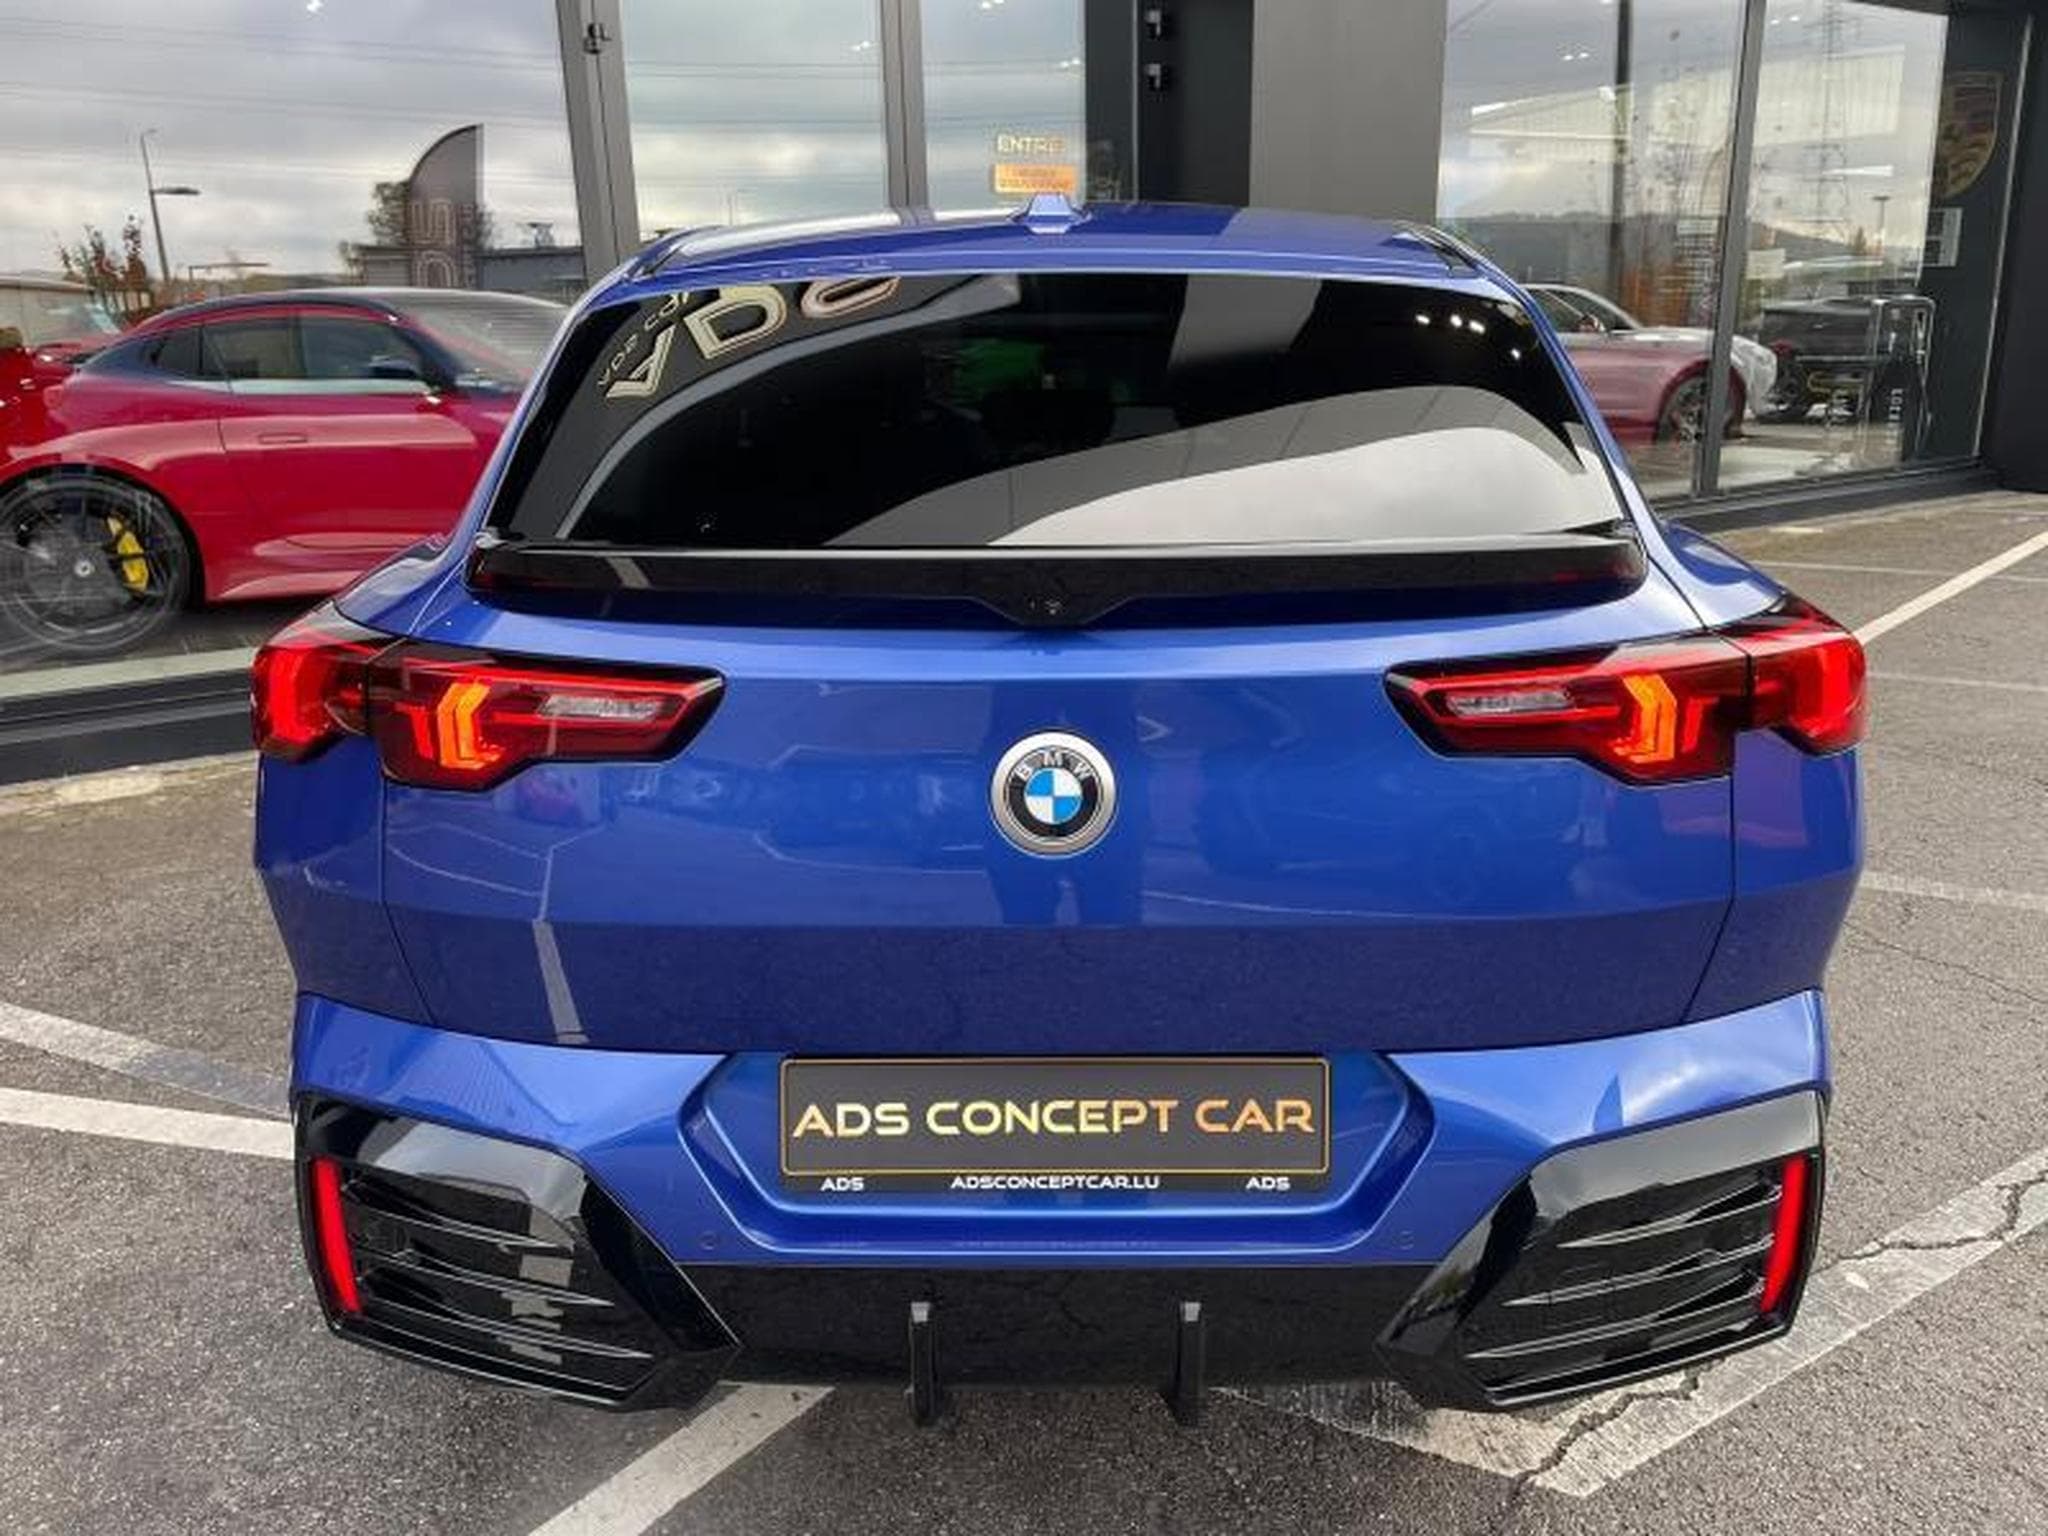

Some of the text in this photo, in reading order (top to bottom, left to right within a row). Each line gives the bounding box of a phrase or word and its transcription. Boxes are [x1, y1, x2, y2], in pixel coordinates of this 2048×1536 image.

[1014, 749, 1095, 782] BMW
[792, 1098, 1315, 1138] ADS CONCEPT CAR
[820, 1177, 865, 1192] ADS
[951, 1175, 1161, 1190] ADSCONCEPTCAR.LU
[1245, 1176, 1291, 1191] ADS
